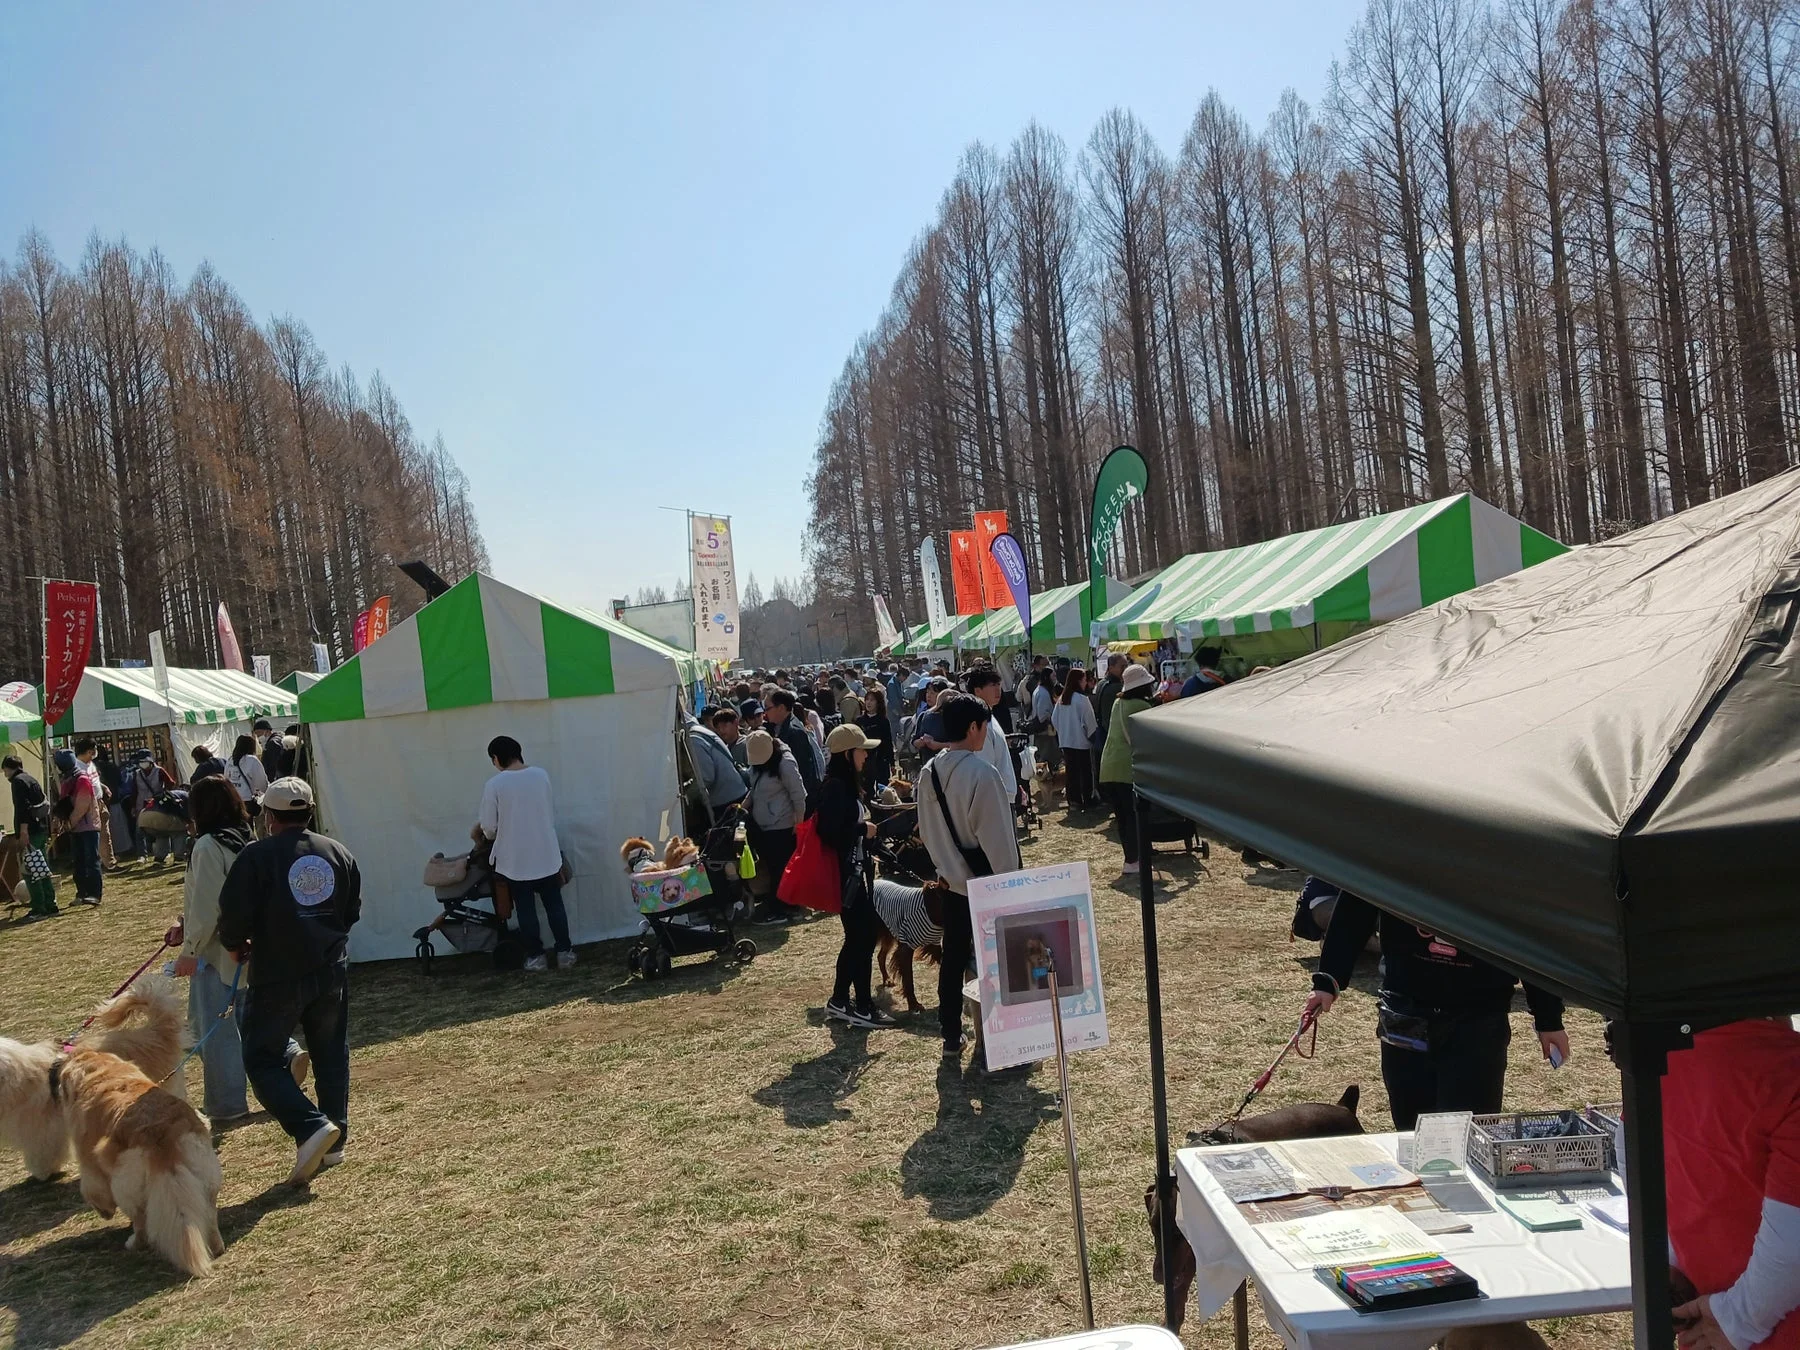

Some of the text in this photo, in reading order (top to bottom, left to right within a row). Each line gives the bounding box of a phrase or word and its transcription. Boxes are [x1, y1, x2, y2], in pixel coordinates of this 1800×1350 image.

[1097, 484, 1125, 541] GREEN
[707, 531, 720, 549] 5
[1101, 521, 1114, 552] DOG
[56, 592, 91, 603] PetKind
